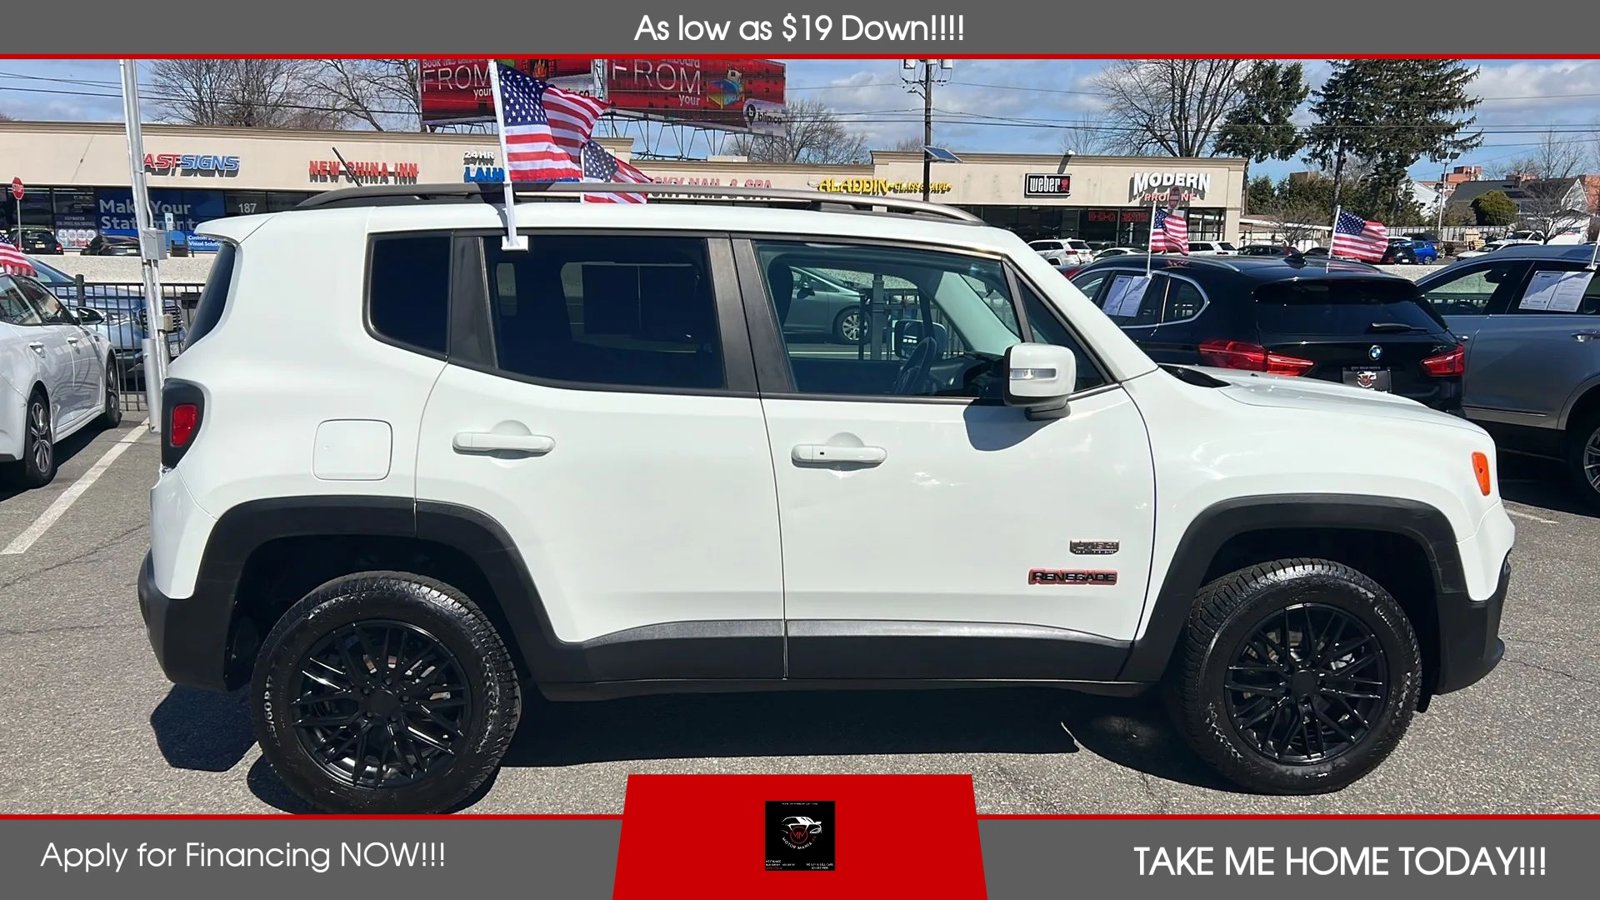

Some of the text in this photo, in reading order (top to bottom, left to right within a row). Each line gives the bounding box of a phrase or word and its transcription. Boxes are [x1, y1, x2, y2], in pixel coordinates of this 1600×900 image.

[422, 64, 491, 92] FROM
[612, 59, 700, 95] FROM
[473, 88, 492, 100] your
[678, 94, 700, 107] your
[144, 153, 240, 171] ASTSIGNS
[309, 161, 417, 178] NEW CHINA INN
[818, 178, 889, 194] ALADDIN
[1029, 175, 1061, 192] weber
[1133, 172, 1210, 196] MODERN
[100, 199, 137, 214] Mak
[149, 200, 191, 214] Your
[239, 203, 257, 213] 187
[1029, 569, 1118, 585] RENEGADE
